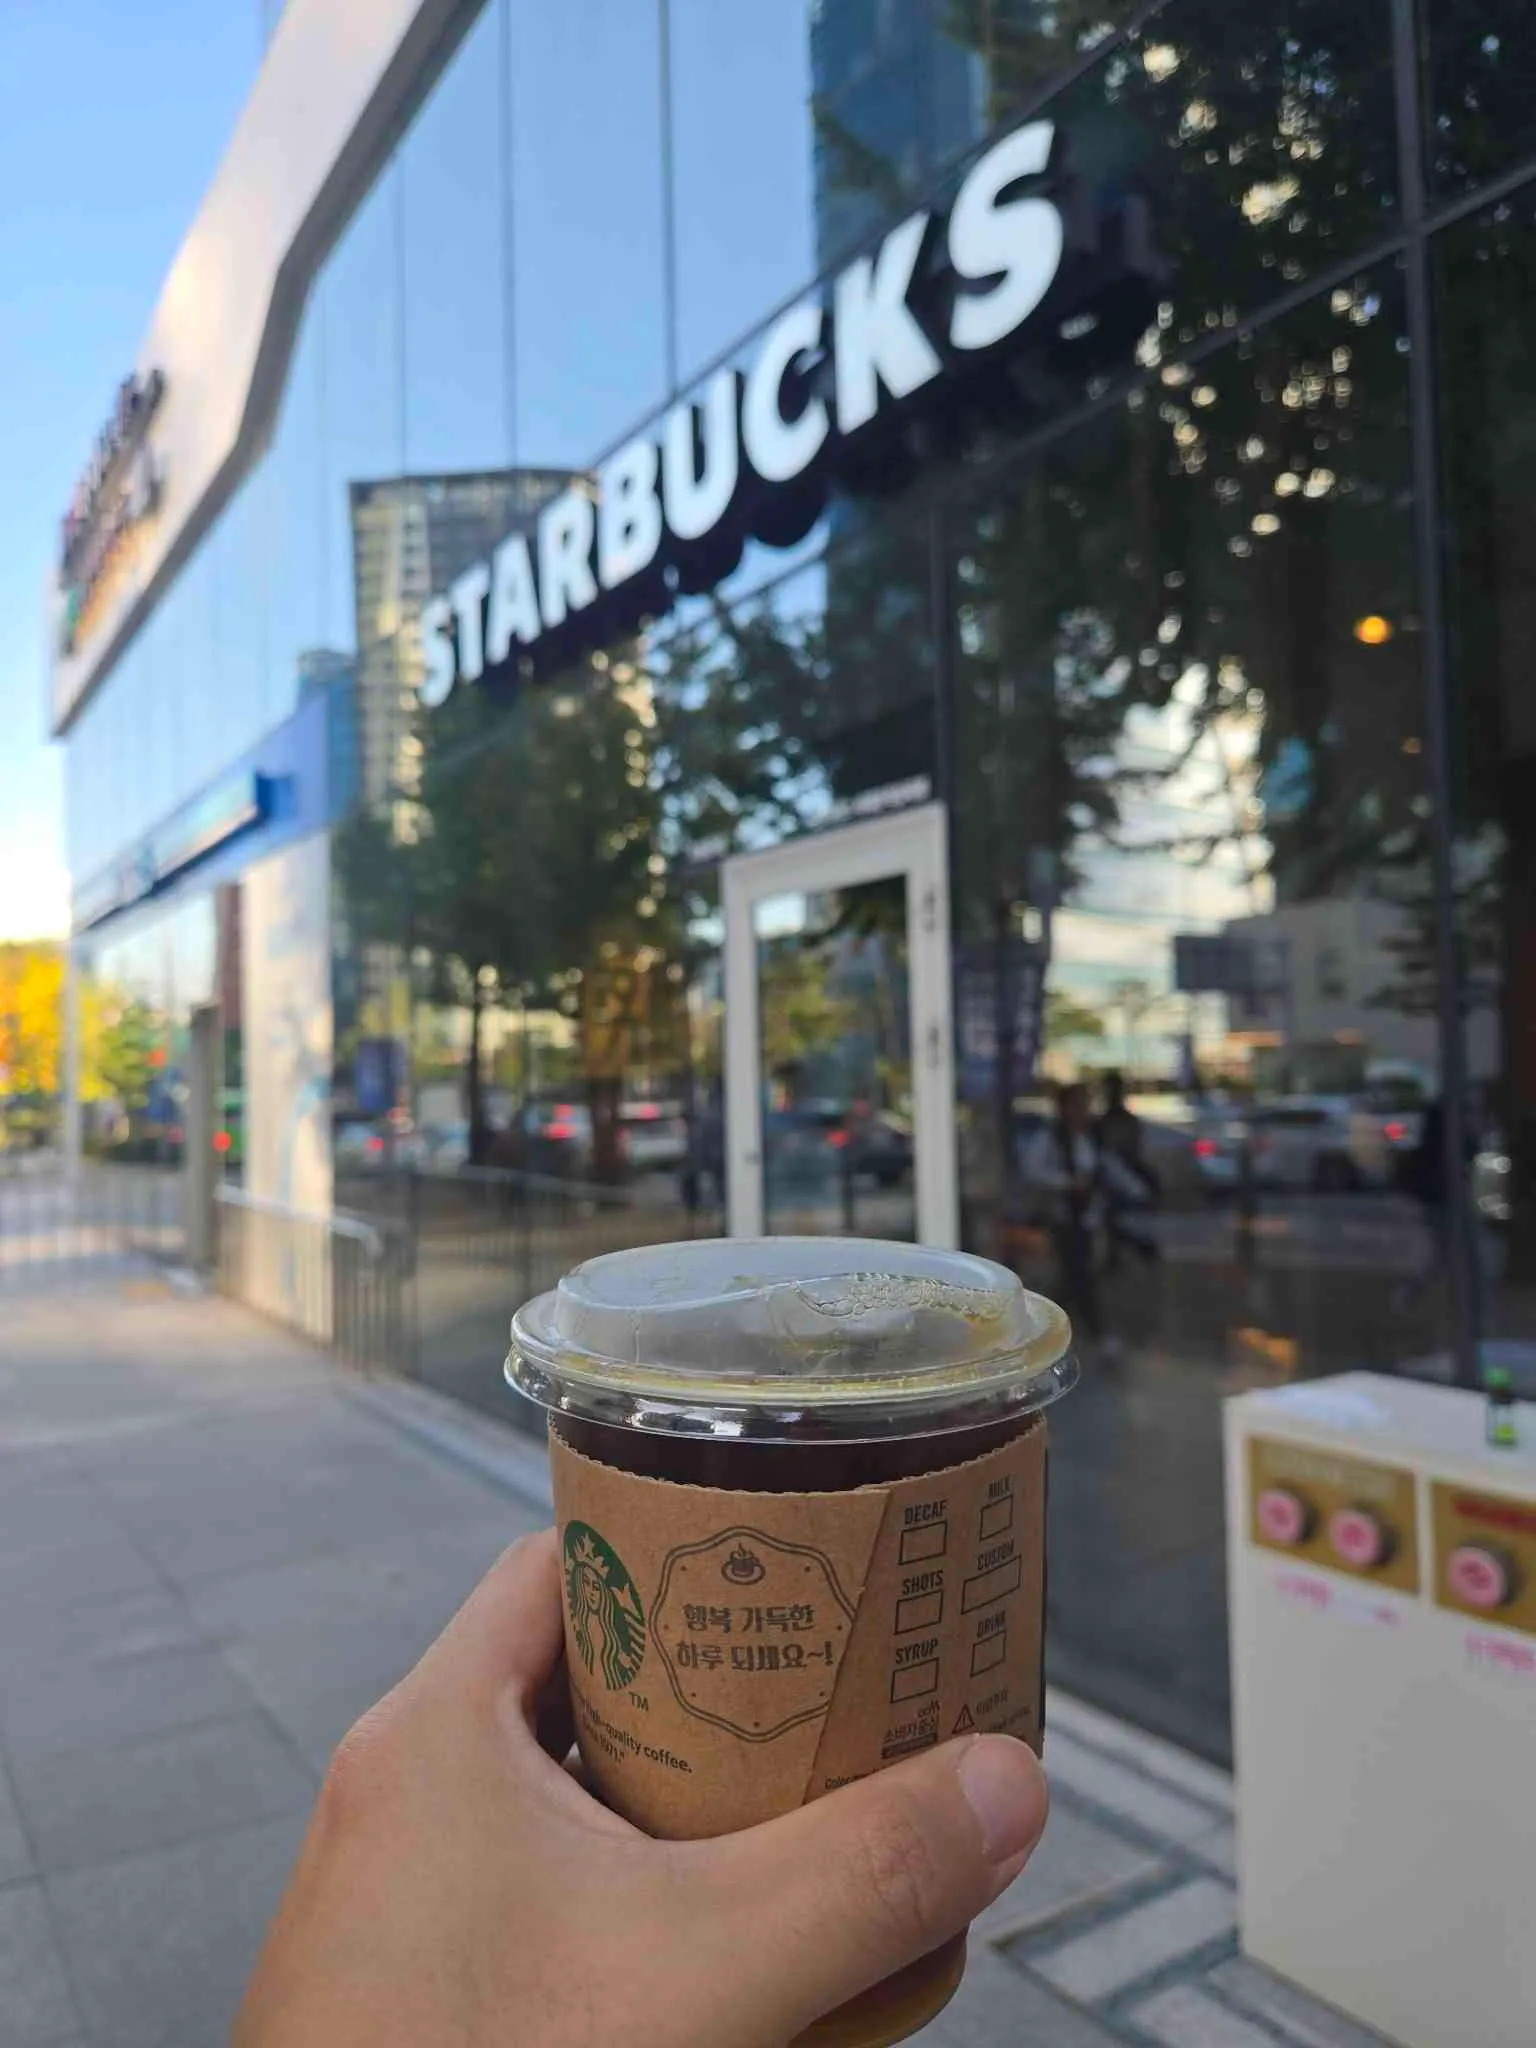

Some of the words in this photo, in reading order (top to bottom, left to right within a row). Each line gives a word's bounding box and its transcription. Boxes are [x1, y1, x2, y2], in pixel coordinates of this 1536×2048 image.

[419, 118, 1063, 707] STARBUCKS
[988, 1475, 1010, 1498] MILK
[904, 1499, 949, 1525] DECAF
[977, 1539, 1015, 1571] CUSTOM
[902, 1569, 944, 1596] SHOTS
[683, 1603, 731, 1633] 행복
[740, 1603, 815, 1633] 가득한
[977, 1610, 1006, 1638] DRINK
[676, 1640, 724, 1670] 하루
[895, 1638, 939, 1665] SYRUP
[629, 1690, 649, 1712] TM
[643, 1745, 693, 1774] coffee.
